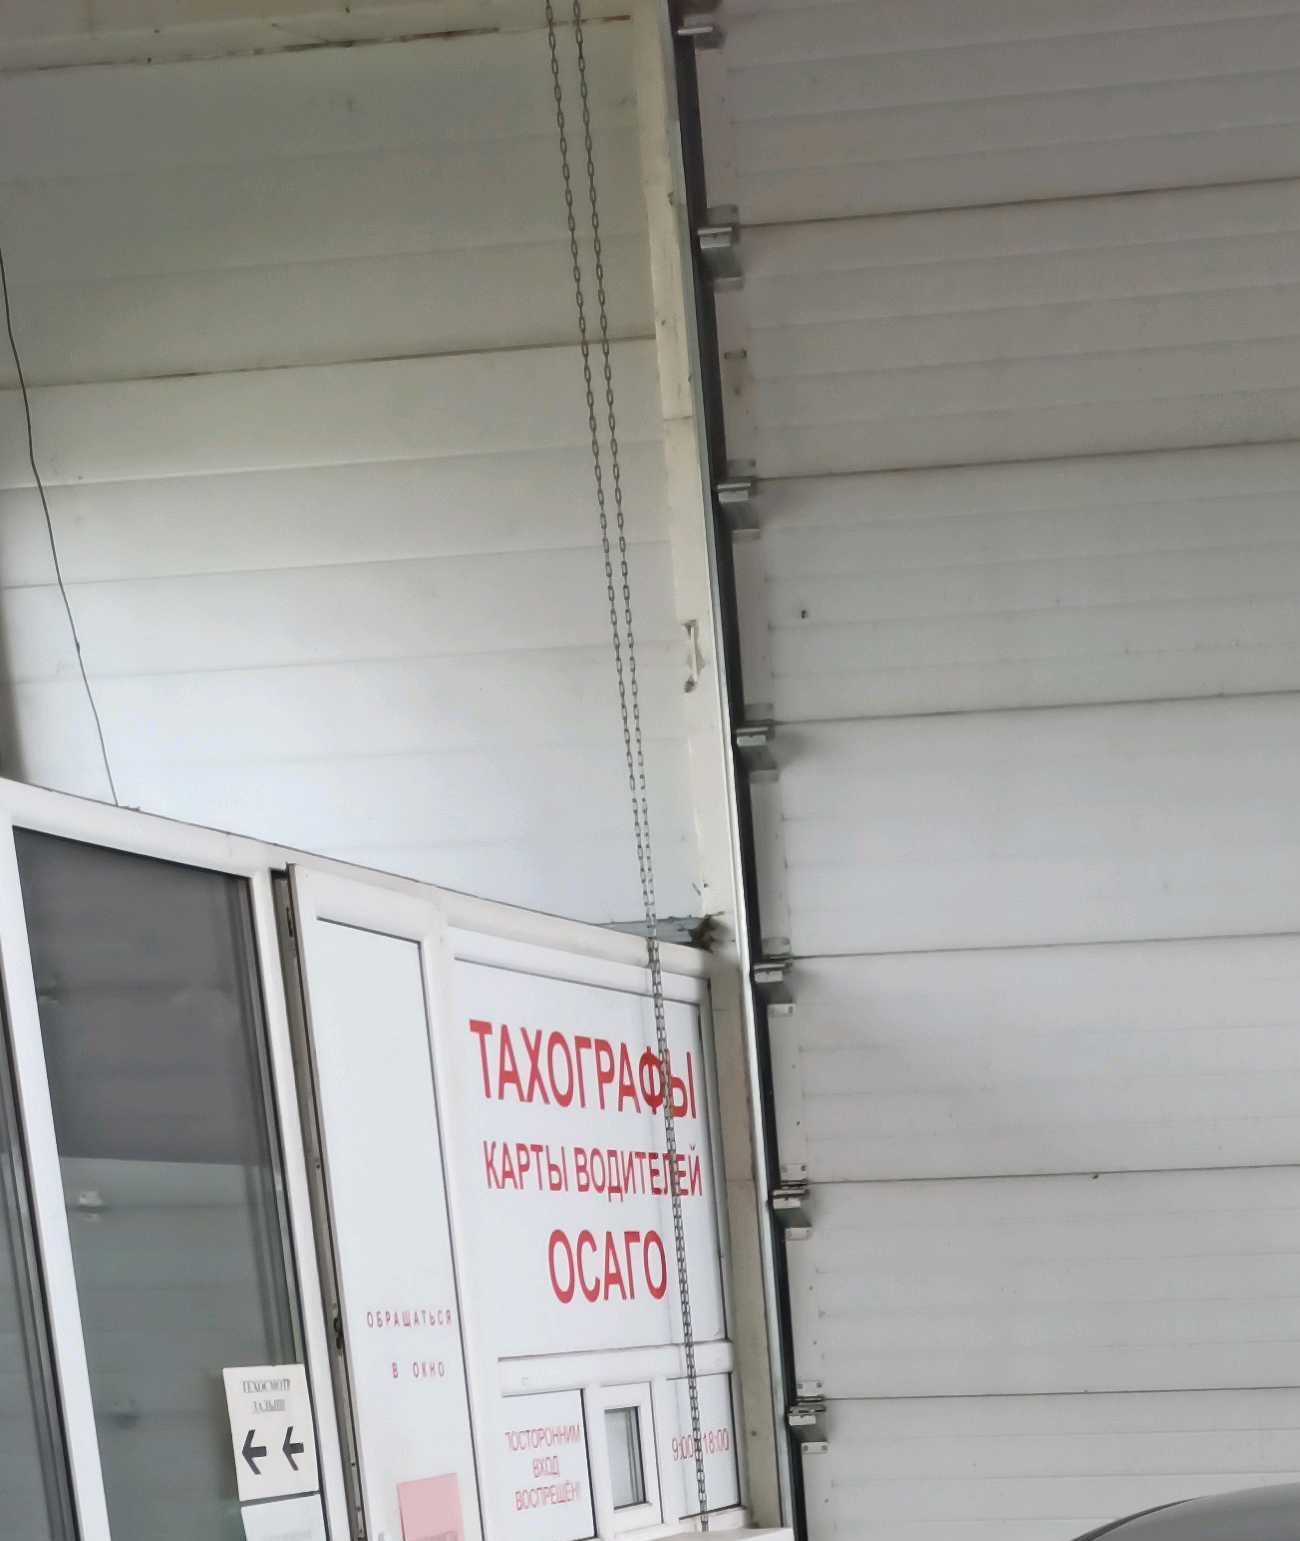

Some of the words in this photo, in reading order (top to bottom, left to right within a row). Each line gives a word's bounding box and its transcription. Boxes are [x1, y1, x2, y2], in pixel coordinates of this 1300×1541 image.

[468, 1018, 698, 1120] ТАХОГРАФЫ
[483, 1140, 569, 1193] КАРТЫ
[573, 1144, 704, 1203] ВОДИТЕЛЕЙ
[547, 1228, 670, 1305] ОСАГО
[366, 1309, 452, 1329] ОБРАЩАТЬСЯ
[391, 1361, 399, 1379] В
[412, 1361, 445, 1378] ОКНО
